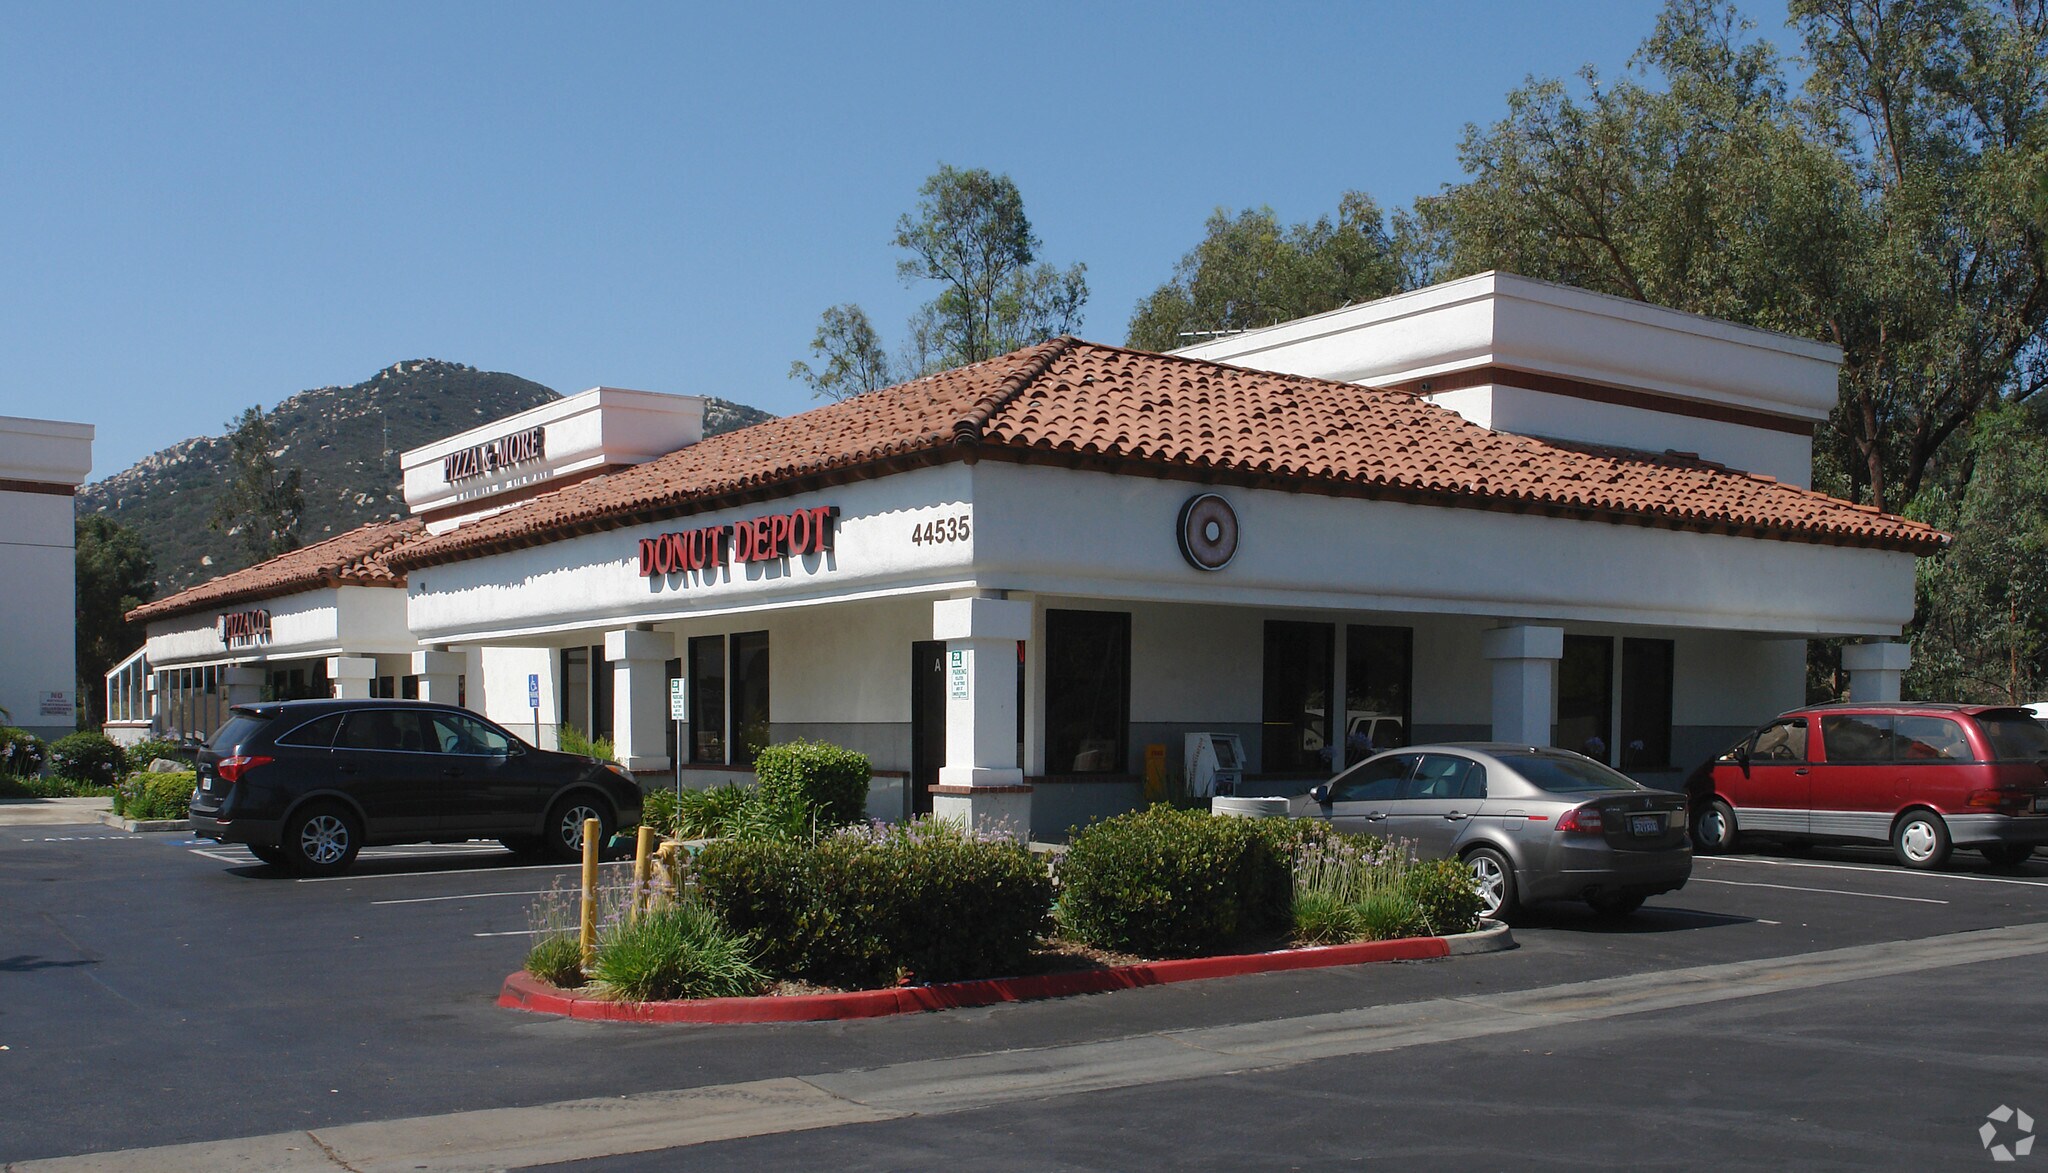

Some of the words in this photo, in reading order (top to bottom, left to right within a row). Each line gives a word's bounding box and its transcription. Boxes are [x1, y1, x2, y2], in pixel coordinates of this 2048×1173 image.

[443, 447, 479, 482] PIZZA
[481, 443, 493, 471] &
[497, 427, 539, 467] MORE
[639, 526, 727, 578] DONUT
[735, 505, 832, 563] DEPOT
[911, 515, 970, 547] 44535
[934, 658, 941, 672] A
[50, 691, 63, 699] NO
